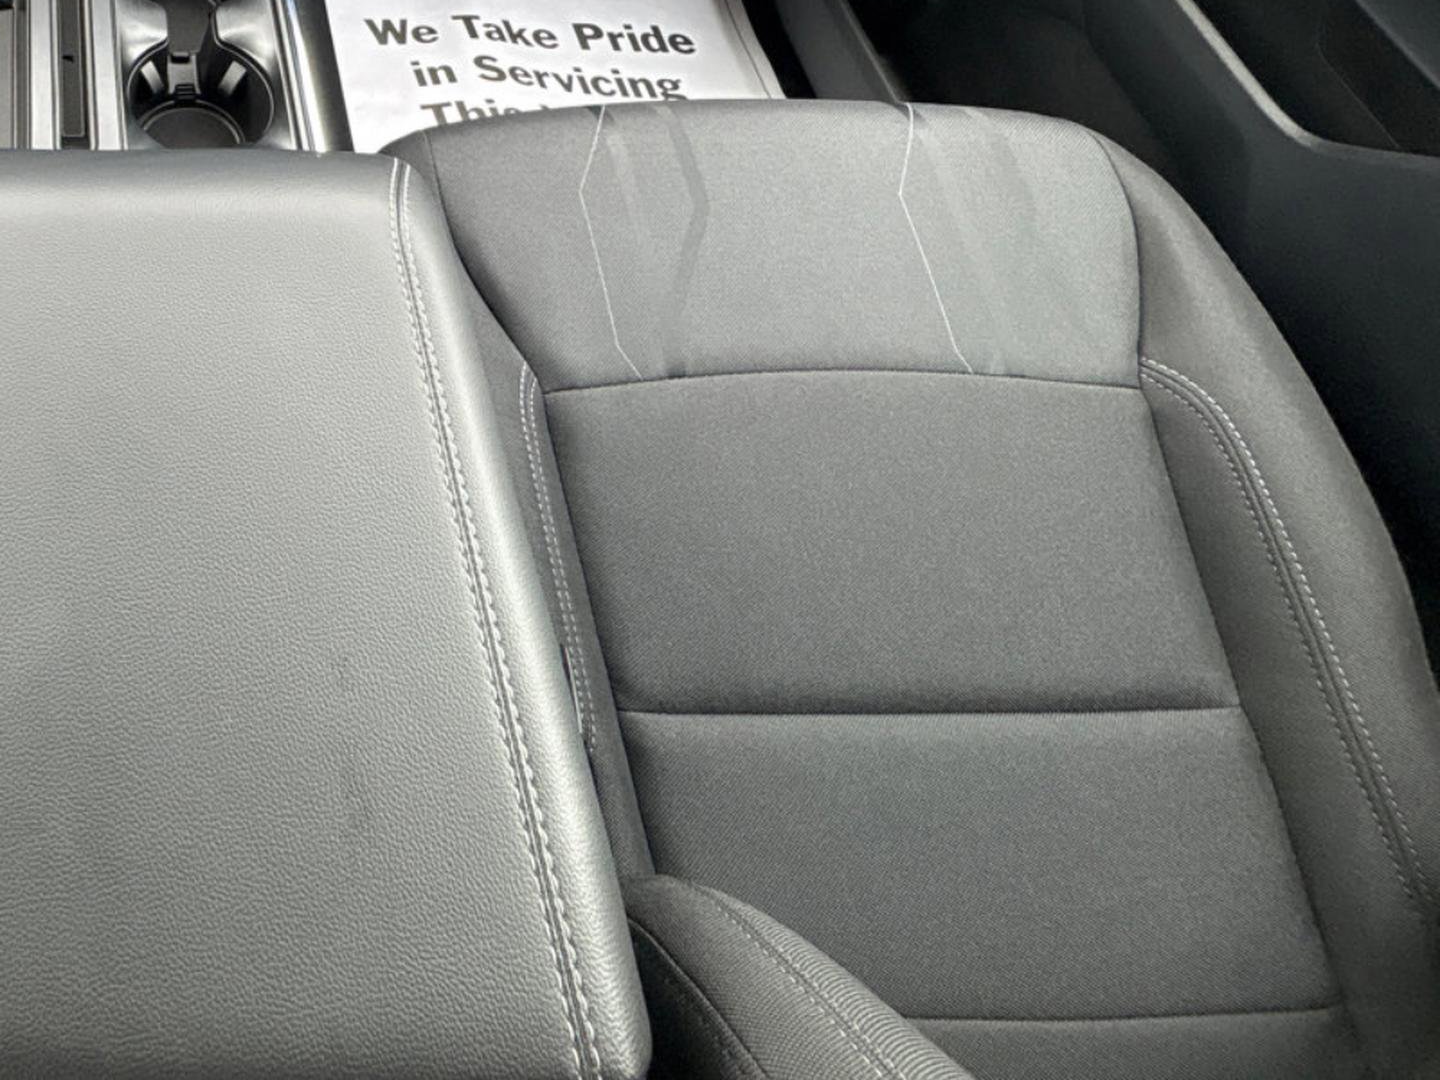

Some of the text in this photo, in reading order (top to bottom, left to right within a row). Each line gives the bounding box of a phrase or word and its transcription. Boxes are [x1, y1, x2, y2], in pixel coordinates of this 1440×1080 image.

[363, 15, 697, 55] We Take Pride
[410, 55, 689, 102] in Servicing
